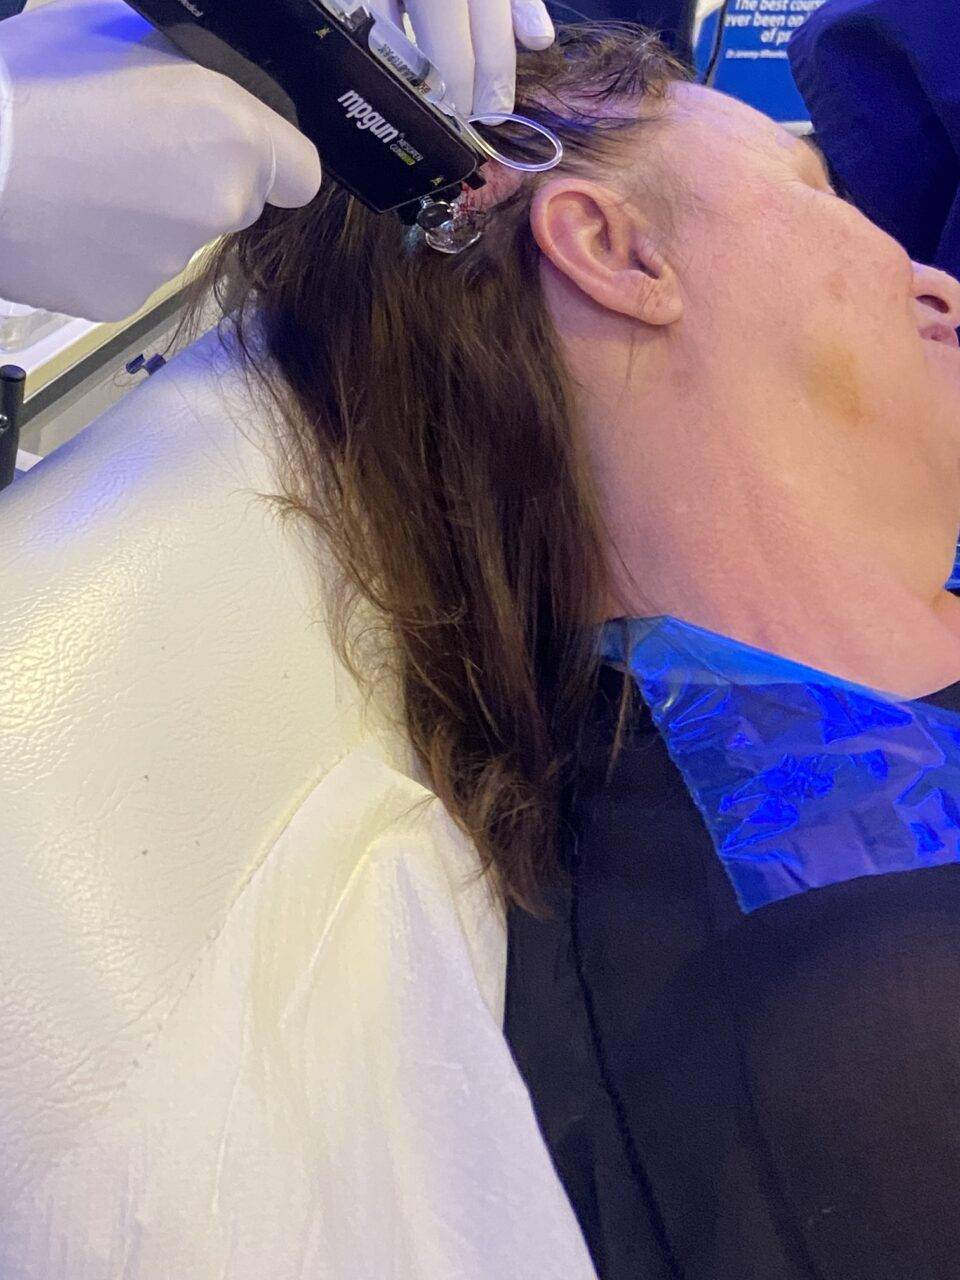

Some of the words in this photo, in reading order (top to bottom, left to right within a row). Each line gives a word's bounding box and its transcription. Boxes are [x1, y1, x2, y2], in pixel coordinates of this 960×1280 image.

[753, 11, 785, 28] been
[786, 15, 805, 27] on
[760, 27, 777, 43] of
[337, 90, 399, 143] mpgun
